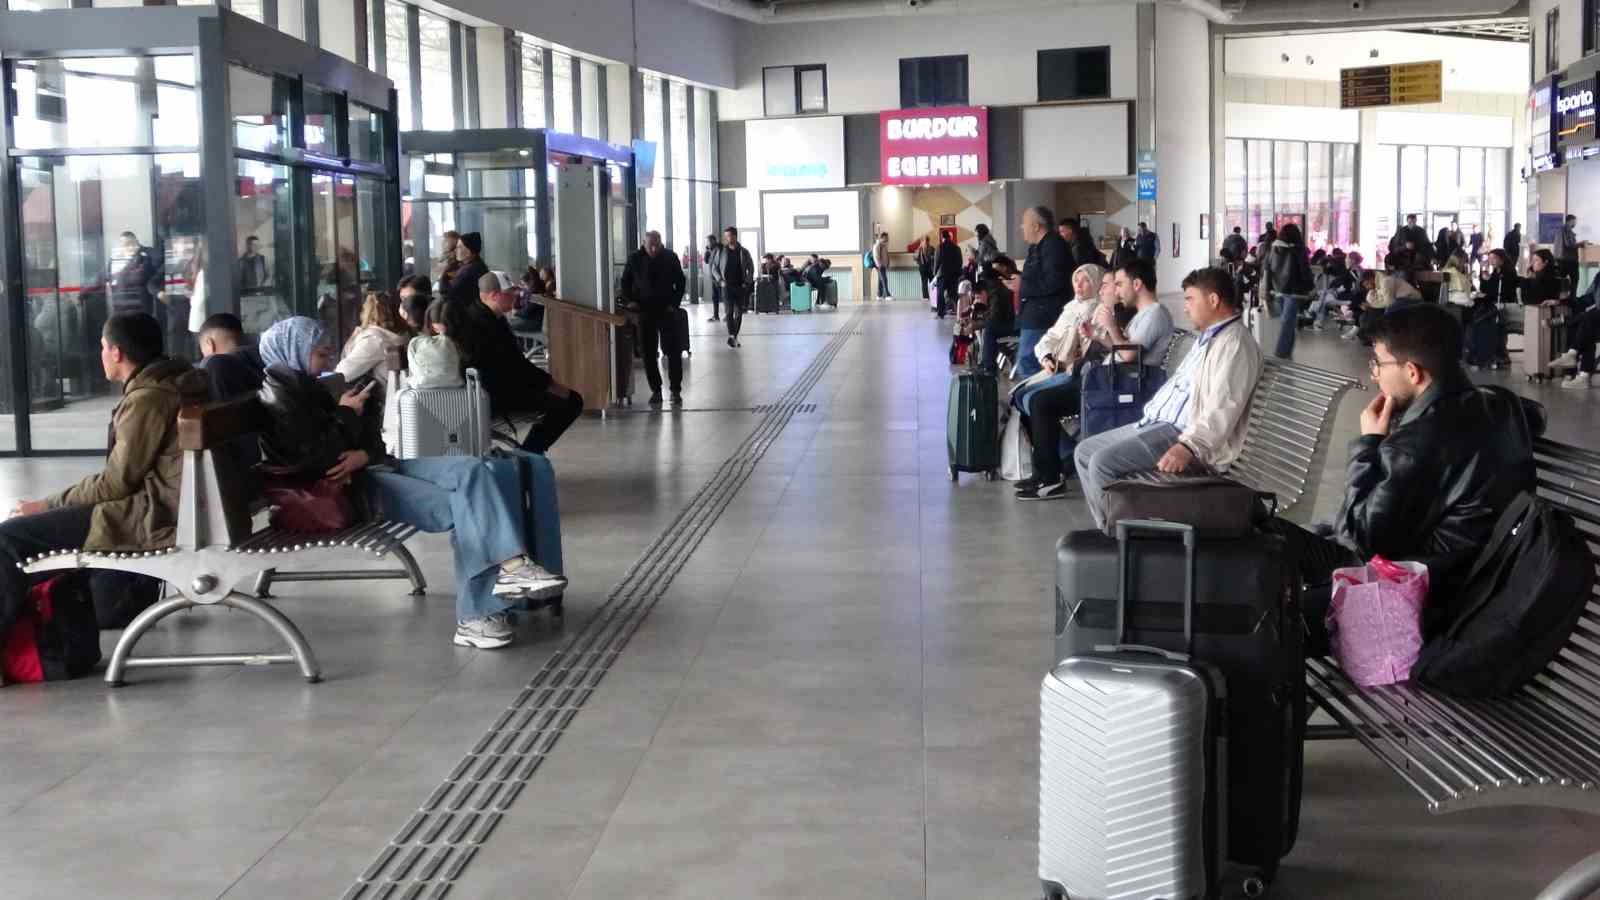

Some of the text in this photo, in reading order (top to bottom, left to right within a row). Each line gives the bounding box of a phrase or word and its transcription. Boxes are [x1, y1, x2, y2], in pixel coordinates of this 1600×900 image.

[887, 116, 978, 140] BURDUR
[887, 154, 978, 178] EGEMEN
[1140, 178, 1155, 189] WC
